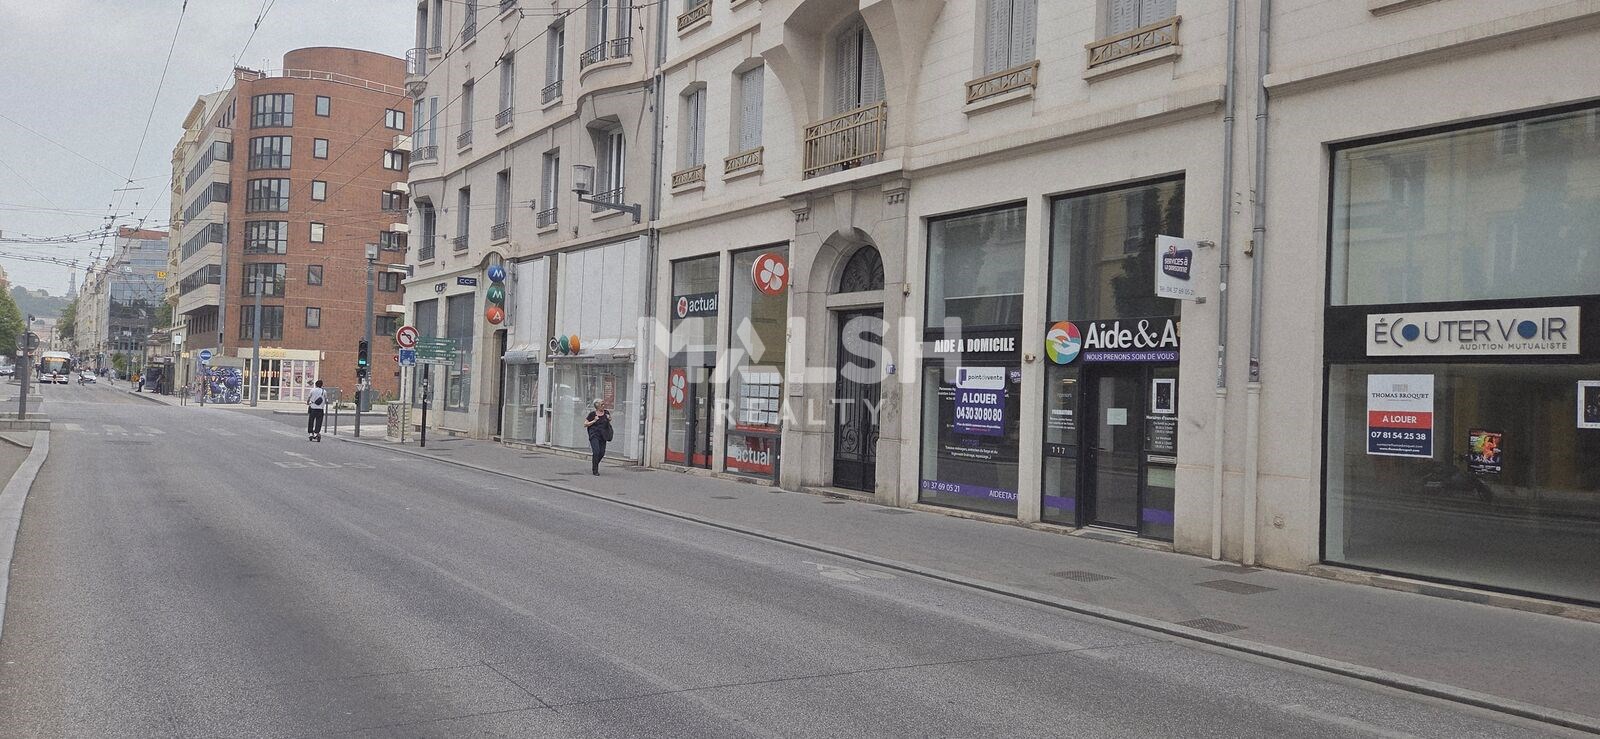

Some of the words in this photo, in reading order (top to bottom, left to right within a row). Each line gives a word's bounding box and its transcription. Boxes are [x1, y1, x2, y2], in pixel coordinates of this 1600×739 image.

[689, 294, 717, 312] actual
[1497, 317, 1567, 342] VOIR
[934, 339, 955, 353] AIDE
[957, 339, 964, 352] A
[967, 337, 1015, 352] DOMICILE
[1507, 342, 1567, 350] MUTUALISTE
[962, 393, 968, 403] A
[969, 393, 997, 404] LOUER
[1391, 415, 1417, 423] LOUER
[736, 447, 770, 466] actual
[931, 481, 937, 489] 37
